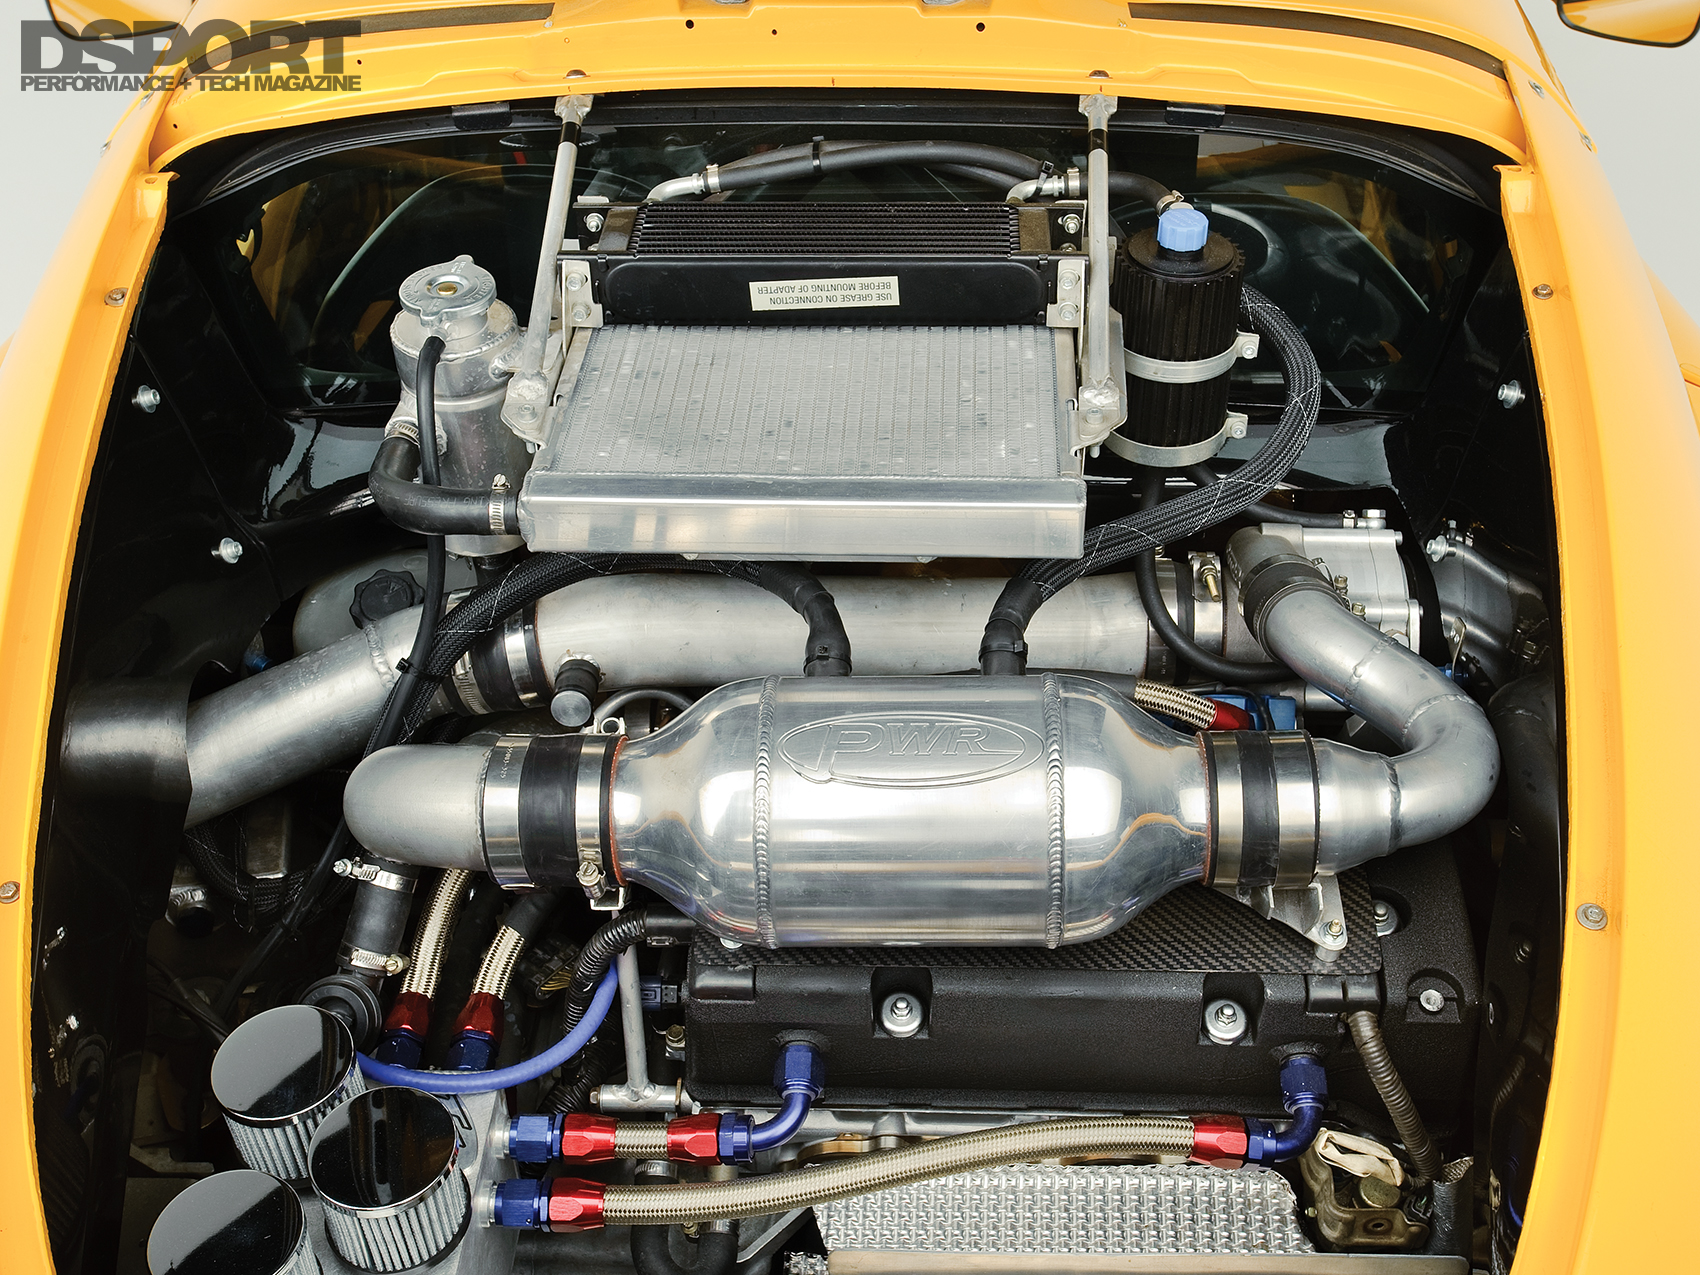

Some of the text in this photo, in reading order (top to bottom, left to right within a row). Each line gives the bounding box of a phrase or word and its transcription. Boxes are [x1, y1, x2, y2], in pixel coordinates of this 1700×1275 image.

[757, 281, 892, 295] BEFORE MOUNTING OF ADAPTER
[769, 292, 892, 305] USE GREASE ON CONNECTION
[815, 722, 1016, 774] PWR
